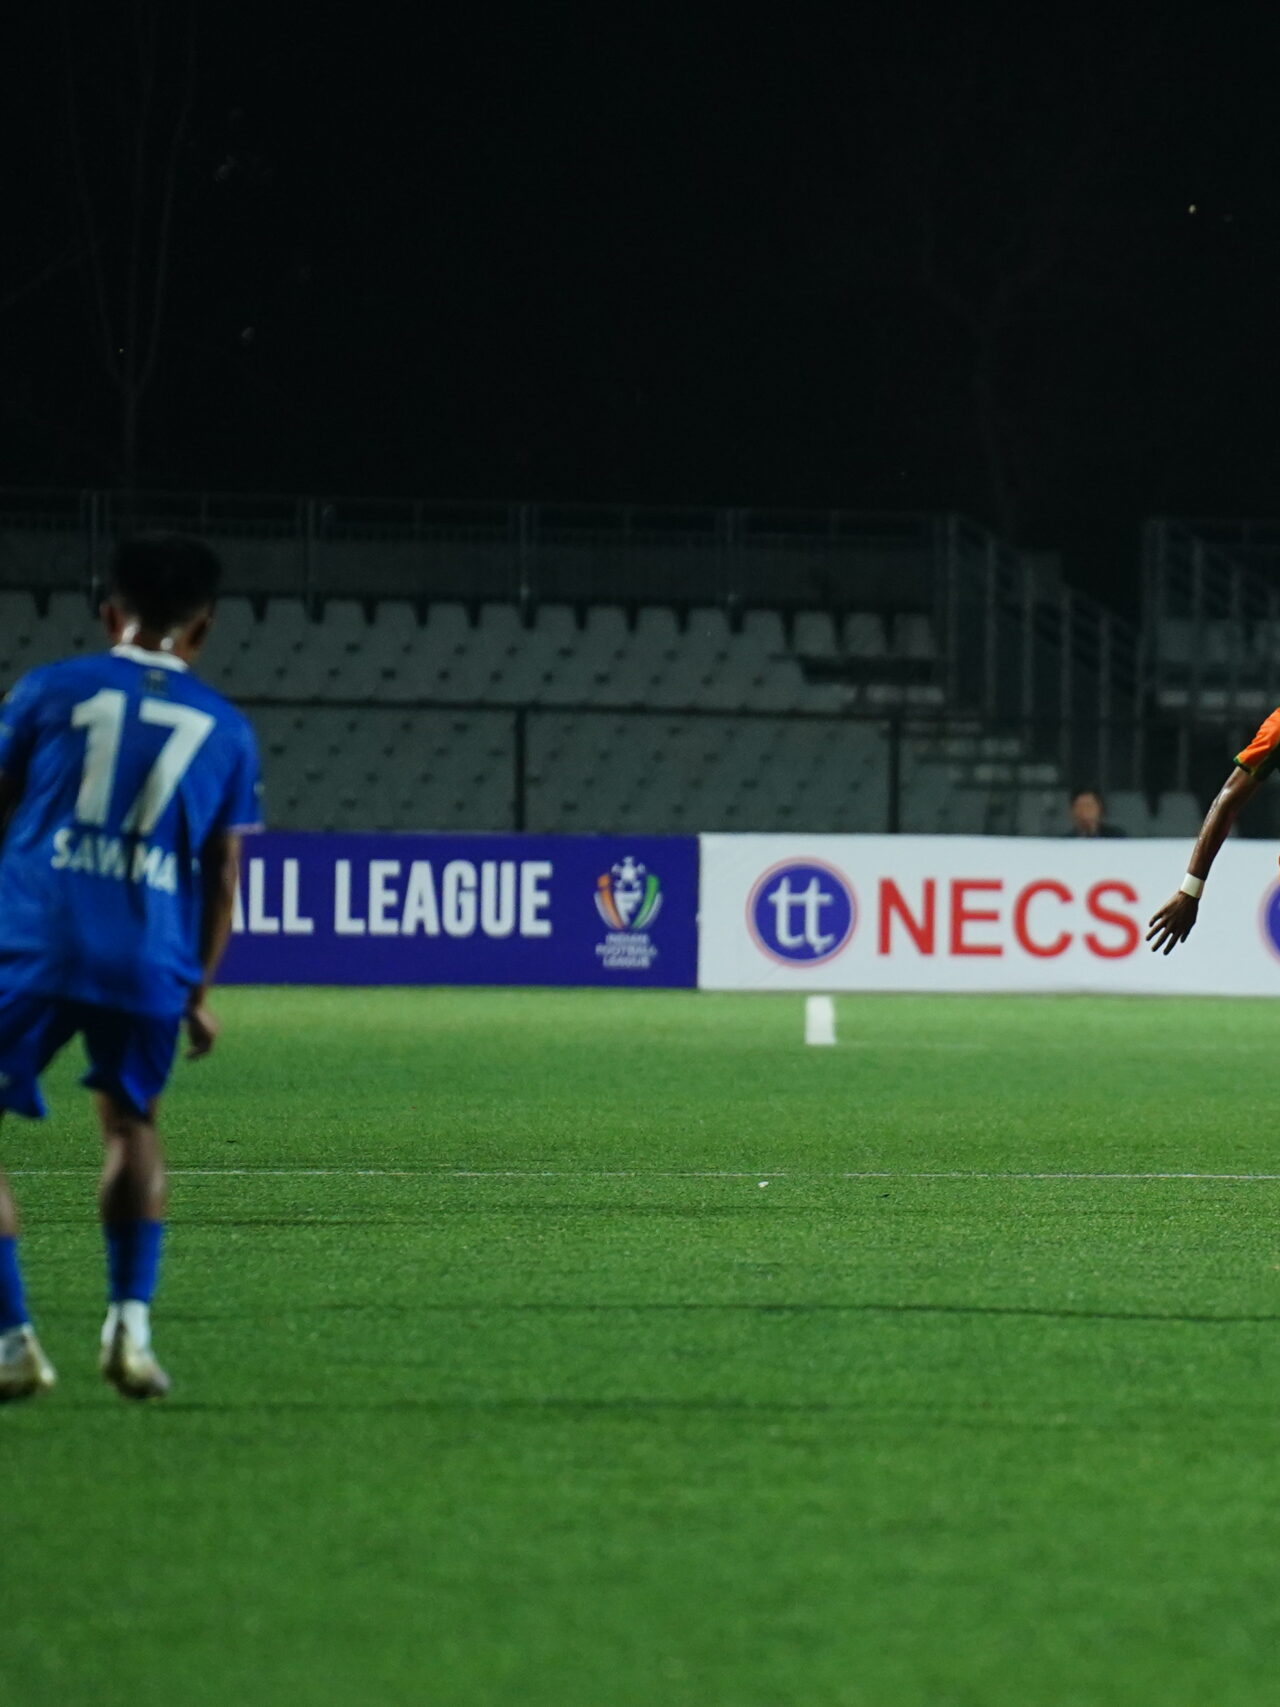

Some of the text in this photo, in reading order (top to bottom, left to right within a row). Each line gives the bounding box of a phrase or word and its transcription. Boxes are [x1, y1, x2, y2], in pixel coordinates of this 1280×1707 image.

[71, 688, 216, 835] 17
[335, 860, 552, 935] LEAGUE
[877, 878, 1139, 959] NECS
